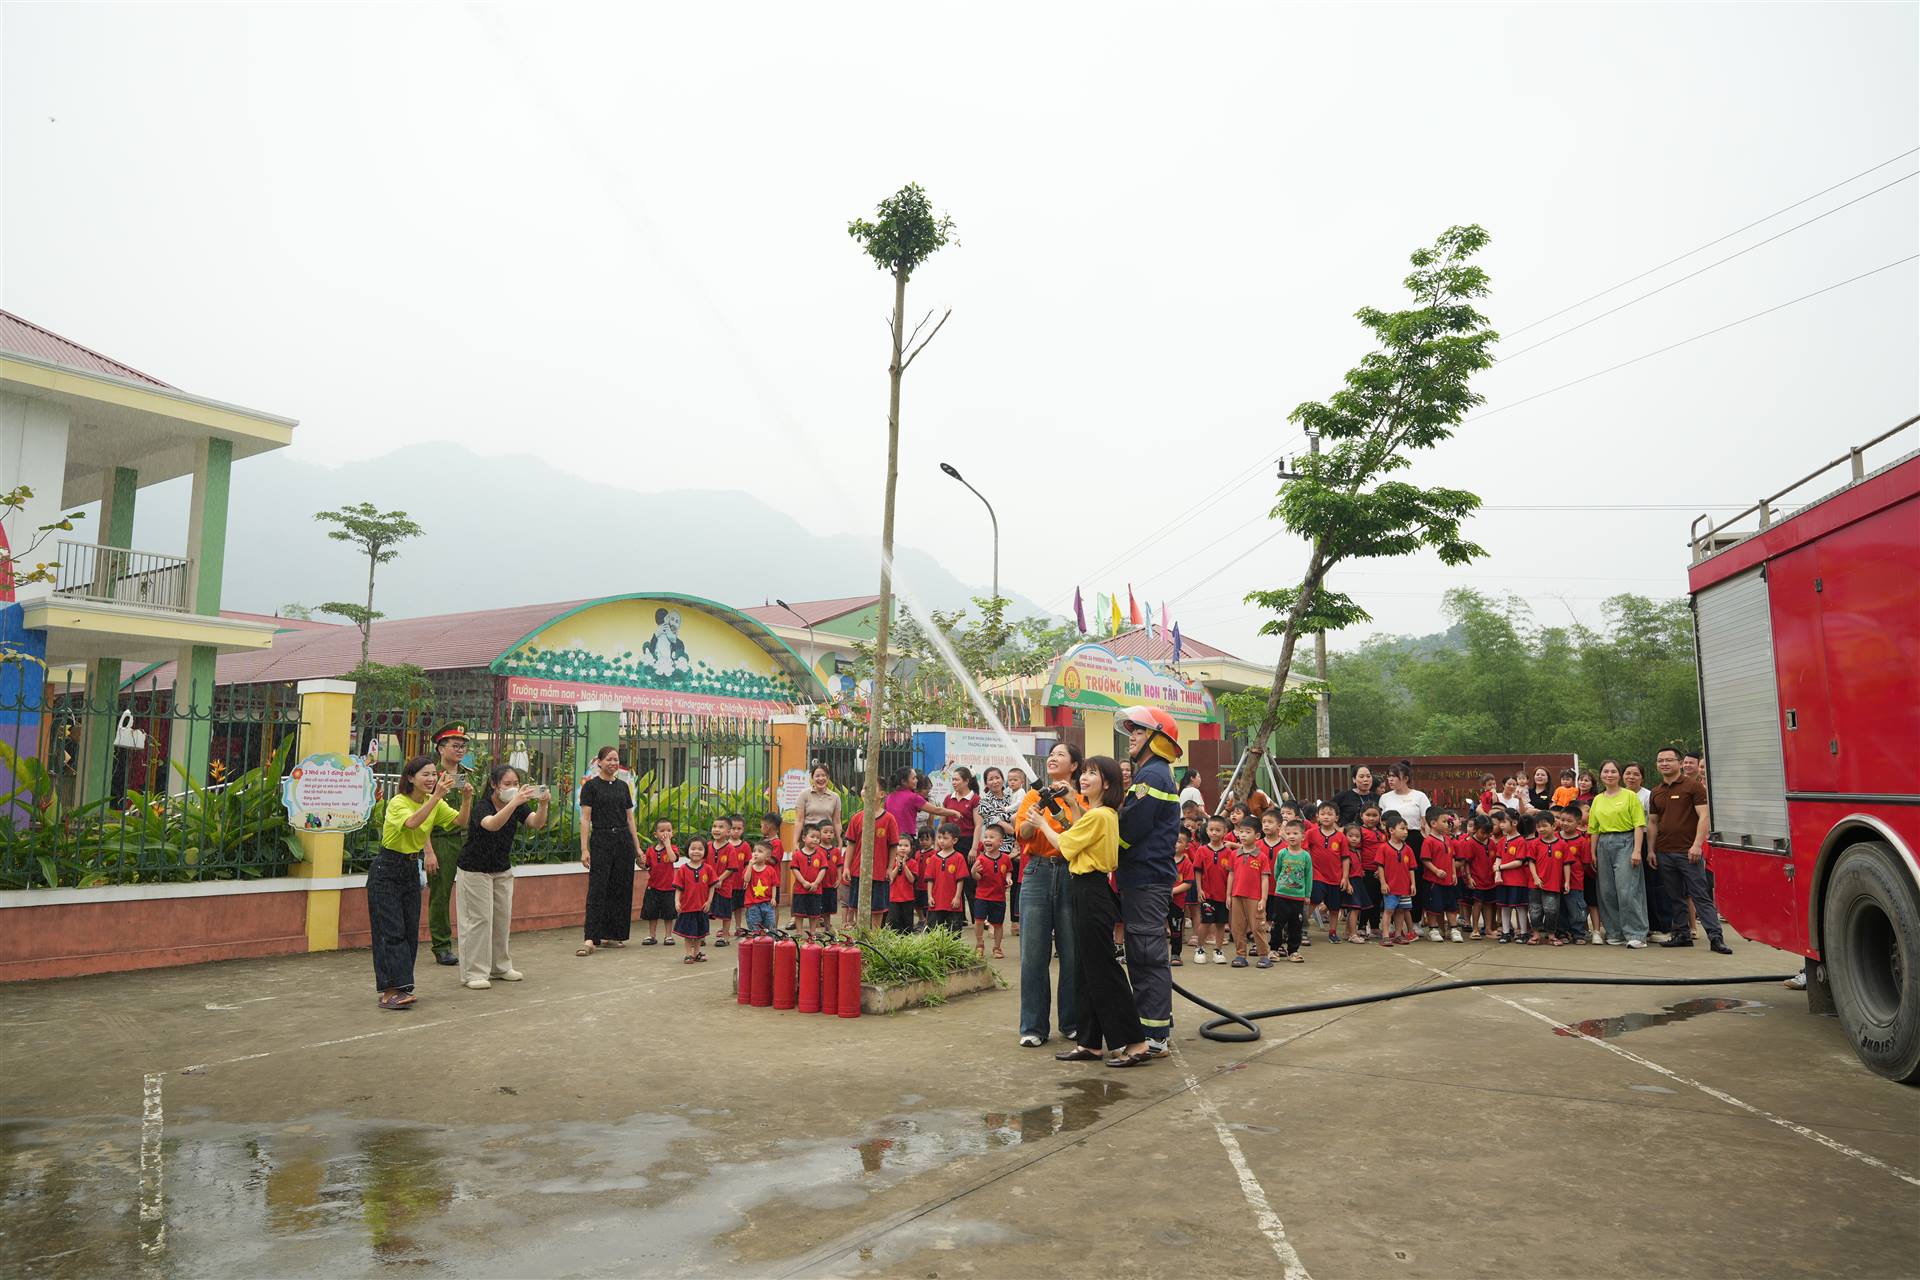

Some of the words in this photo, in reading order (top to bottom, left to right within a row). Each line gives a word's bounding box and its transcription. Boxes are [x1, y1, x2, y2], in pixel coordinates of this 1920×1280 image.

[512, 684, 538, 698] Trường
[540, 684, 560, 698] mầm
[562, 689, 576, 699] non
[581, 689, 598, 702] Ngôi
[599, 690, 613, 702] nhà
[632, 692, 650, 706] phúc
[1085, 674, 1122, 694] TRƯỜNG
[1124, 676, 1142, 697] MẦM
[1144, 684, 1160, 699] NON
[1163, 685, 1178, 701] TÂN
[1180, 689, 1203, 706] THỊNH
